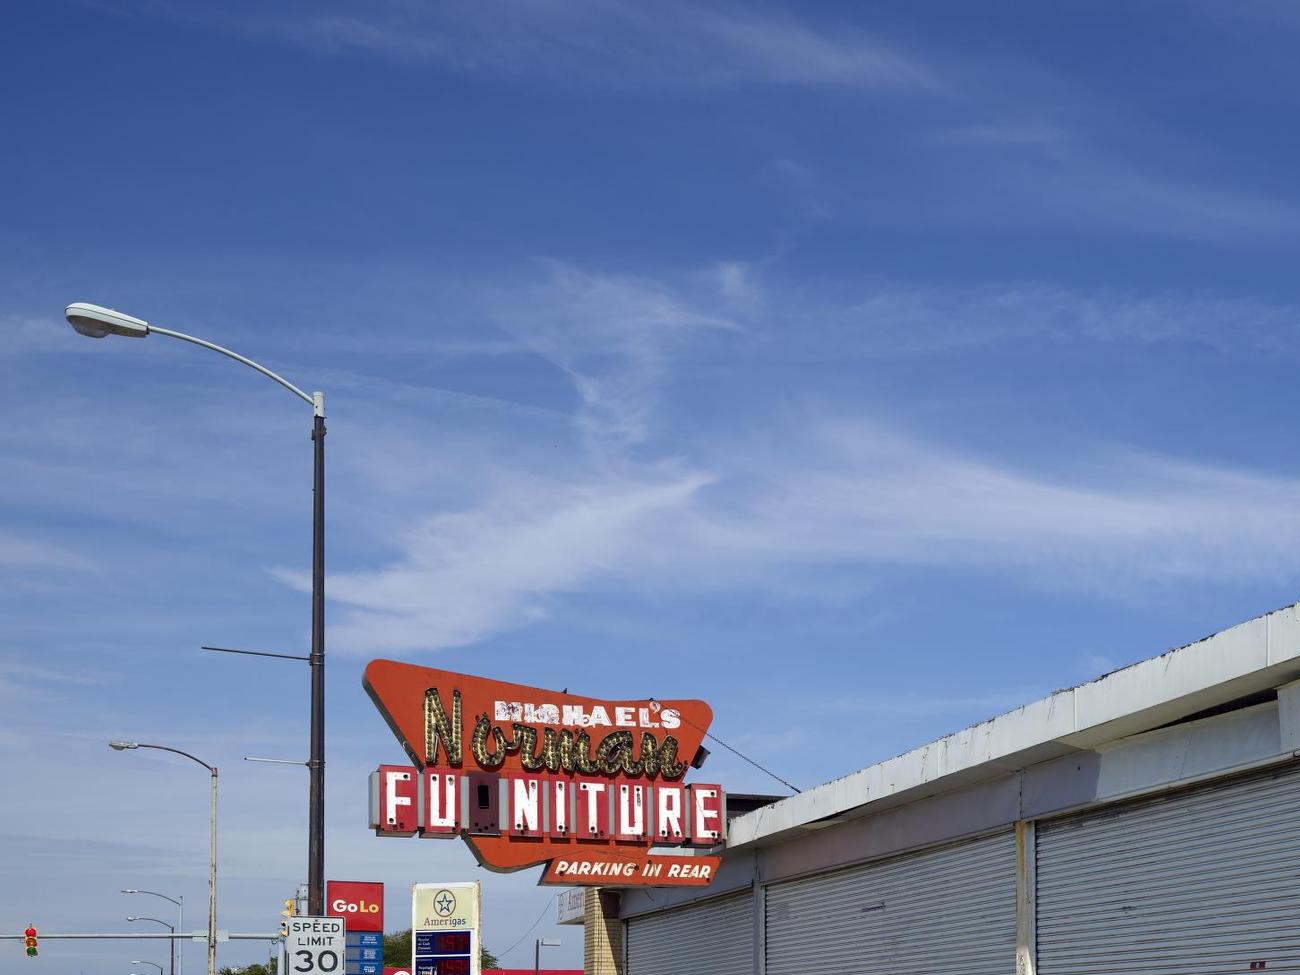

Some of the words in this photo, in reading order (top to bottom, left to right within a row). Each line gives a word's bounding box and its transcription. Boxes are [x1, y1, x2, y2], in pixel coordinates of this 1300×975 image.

[423, 687, 687, 778] Norman
[555, 861, 637, 877] PARKING
[642, 864, 662, 877] IN
[668, 864, 711, 878] REAR
[332, 899, 379, 913] GoLo
[292, 922, 340, 933] SPEED
[424, 917, 466, 927] Amerigas
[298, 936, 334, 946] LIMIT
[294, 950, 338, 972] 30
